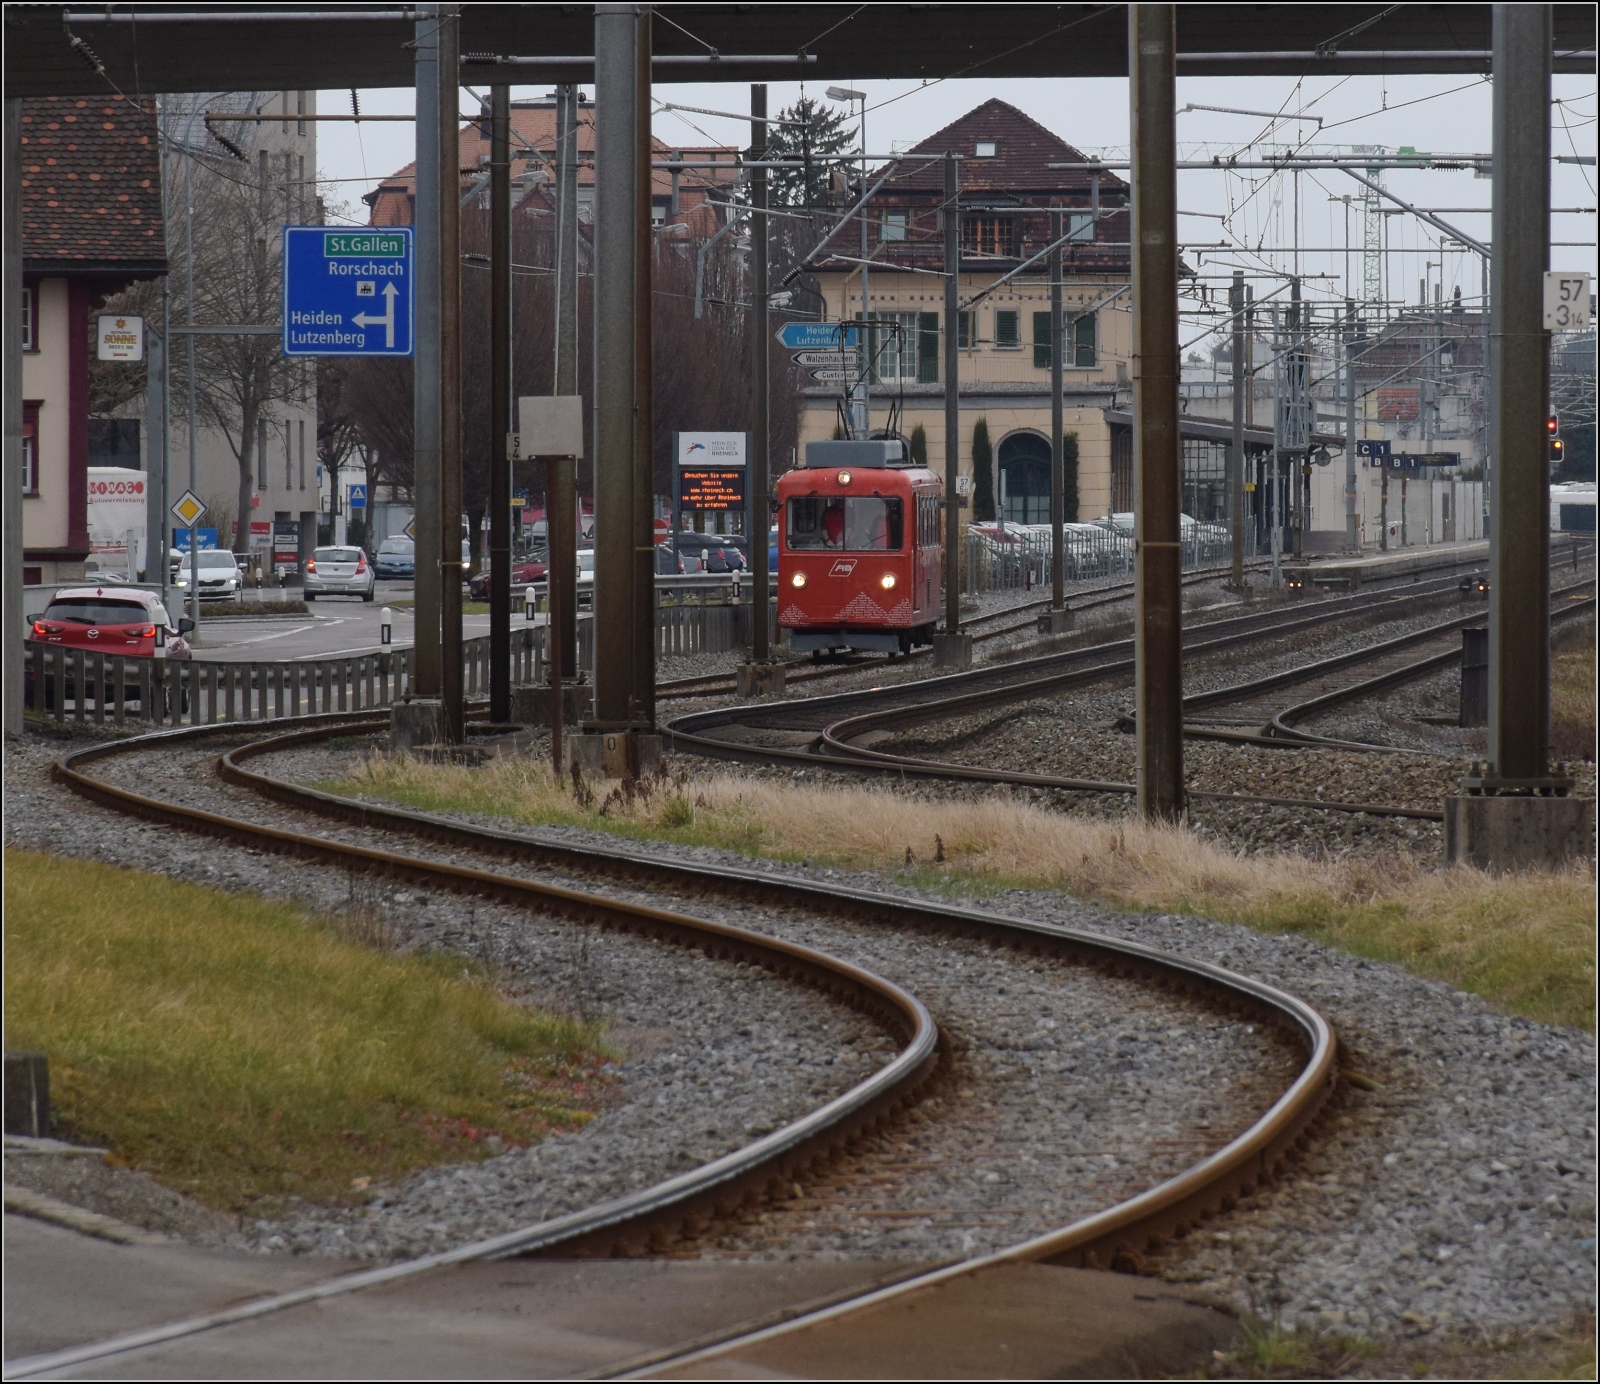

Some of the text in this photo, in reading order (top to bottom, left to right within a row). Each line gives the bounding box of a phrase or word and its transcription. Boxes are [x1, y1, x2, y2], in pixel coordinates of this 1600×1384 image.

[331, 237, 398, 252] St.Gallen
[329, 261, 404, 276] Rorschach
[1560, 279, 1584, 302] 57
[291, 310, 342, 325] Heiden
[104, 334, 137, 345] SONNE
[291, 330, 365, 348] Lutzenberg
[796, 336, 846, 347] Lutzenber
[821, 371, 855, 379] Custrhof
[1361, 445, 1384, 454] C 1
[1374, 457, 1381, 466] B
[1394, 458, 1400, 466] B
[1410, 458, 1415, 467] 1
